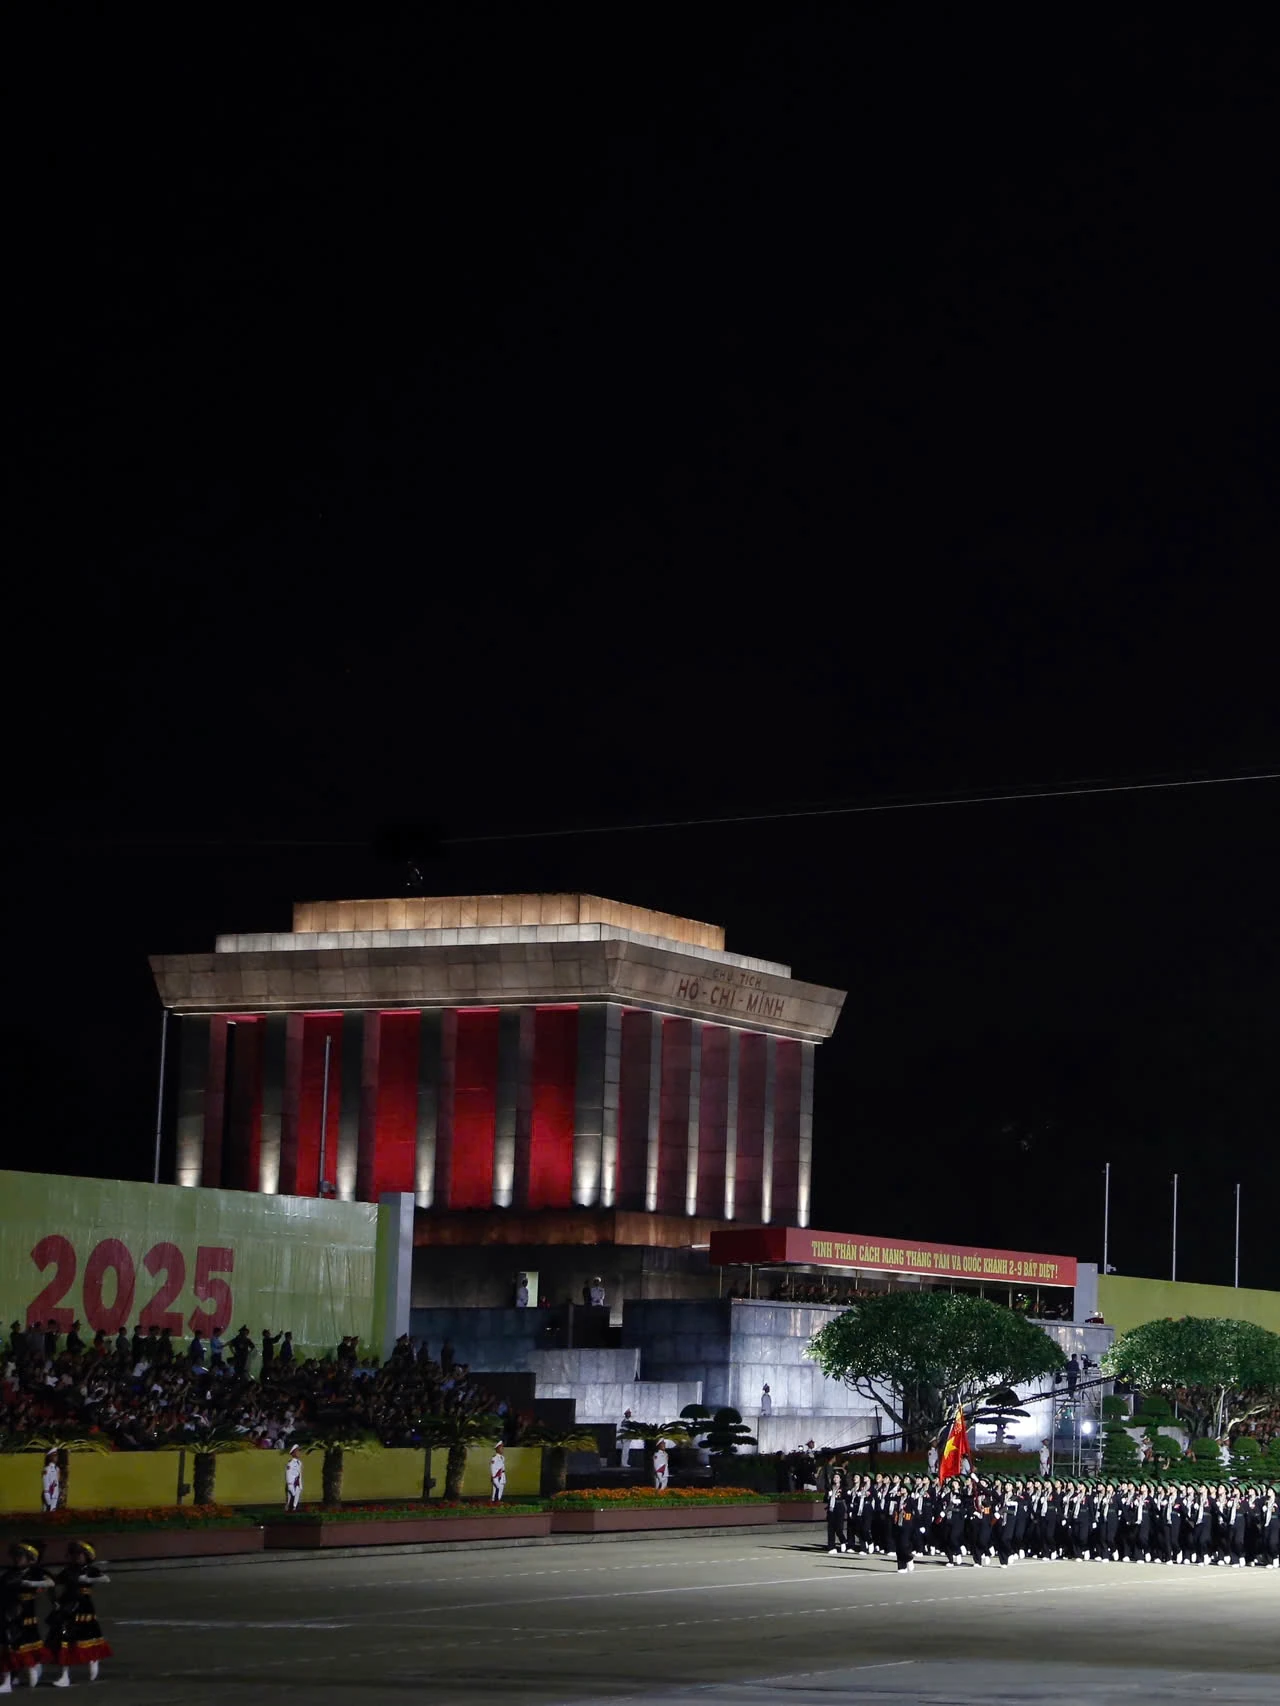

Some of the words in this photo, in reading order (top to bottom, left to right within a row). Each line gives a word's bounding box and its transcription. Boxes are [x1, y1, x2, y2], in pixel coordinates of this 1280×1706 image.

[26, 1234, 235, 1339] 2025
[811, 1241, 833, 1258] TINH
[859, 1243, 880, 1263] CÁCH
[882, 1247, 905, 1267] MẠNG
[906, 1248, 932, 1268] THÁNG
[951, 1252, 962, 1271] VÀ
[963, 1252, 981, 1272] QUỐC
[983, 1256, 1008, 1274] KHÁNH
[1009, 1260, 1022, 1276] 2-9
[1023, 1258, 1038, 1277] BẤT
[1039, 1261, 1058, 1280] DIỆT!
